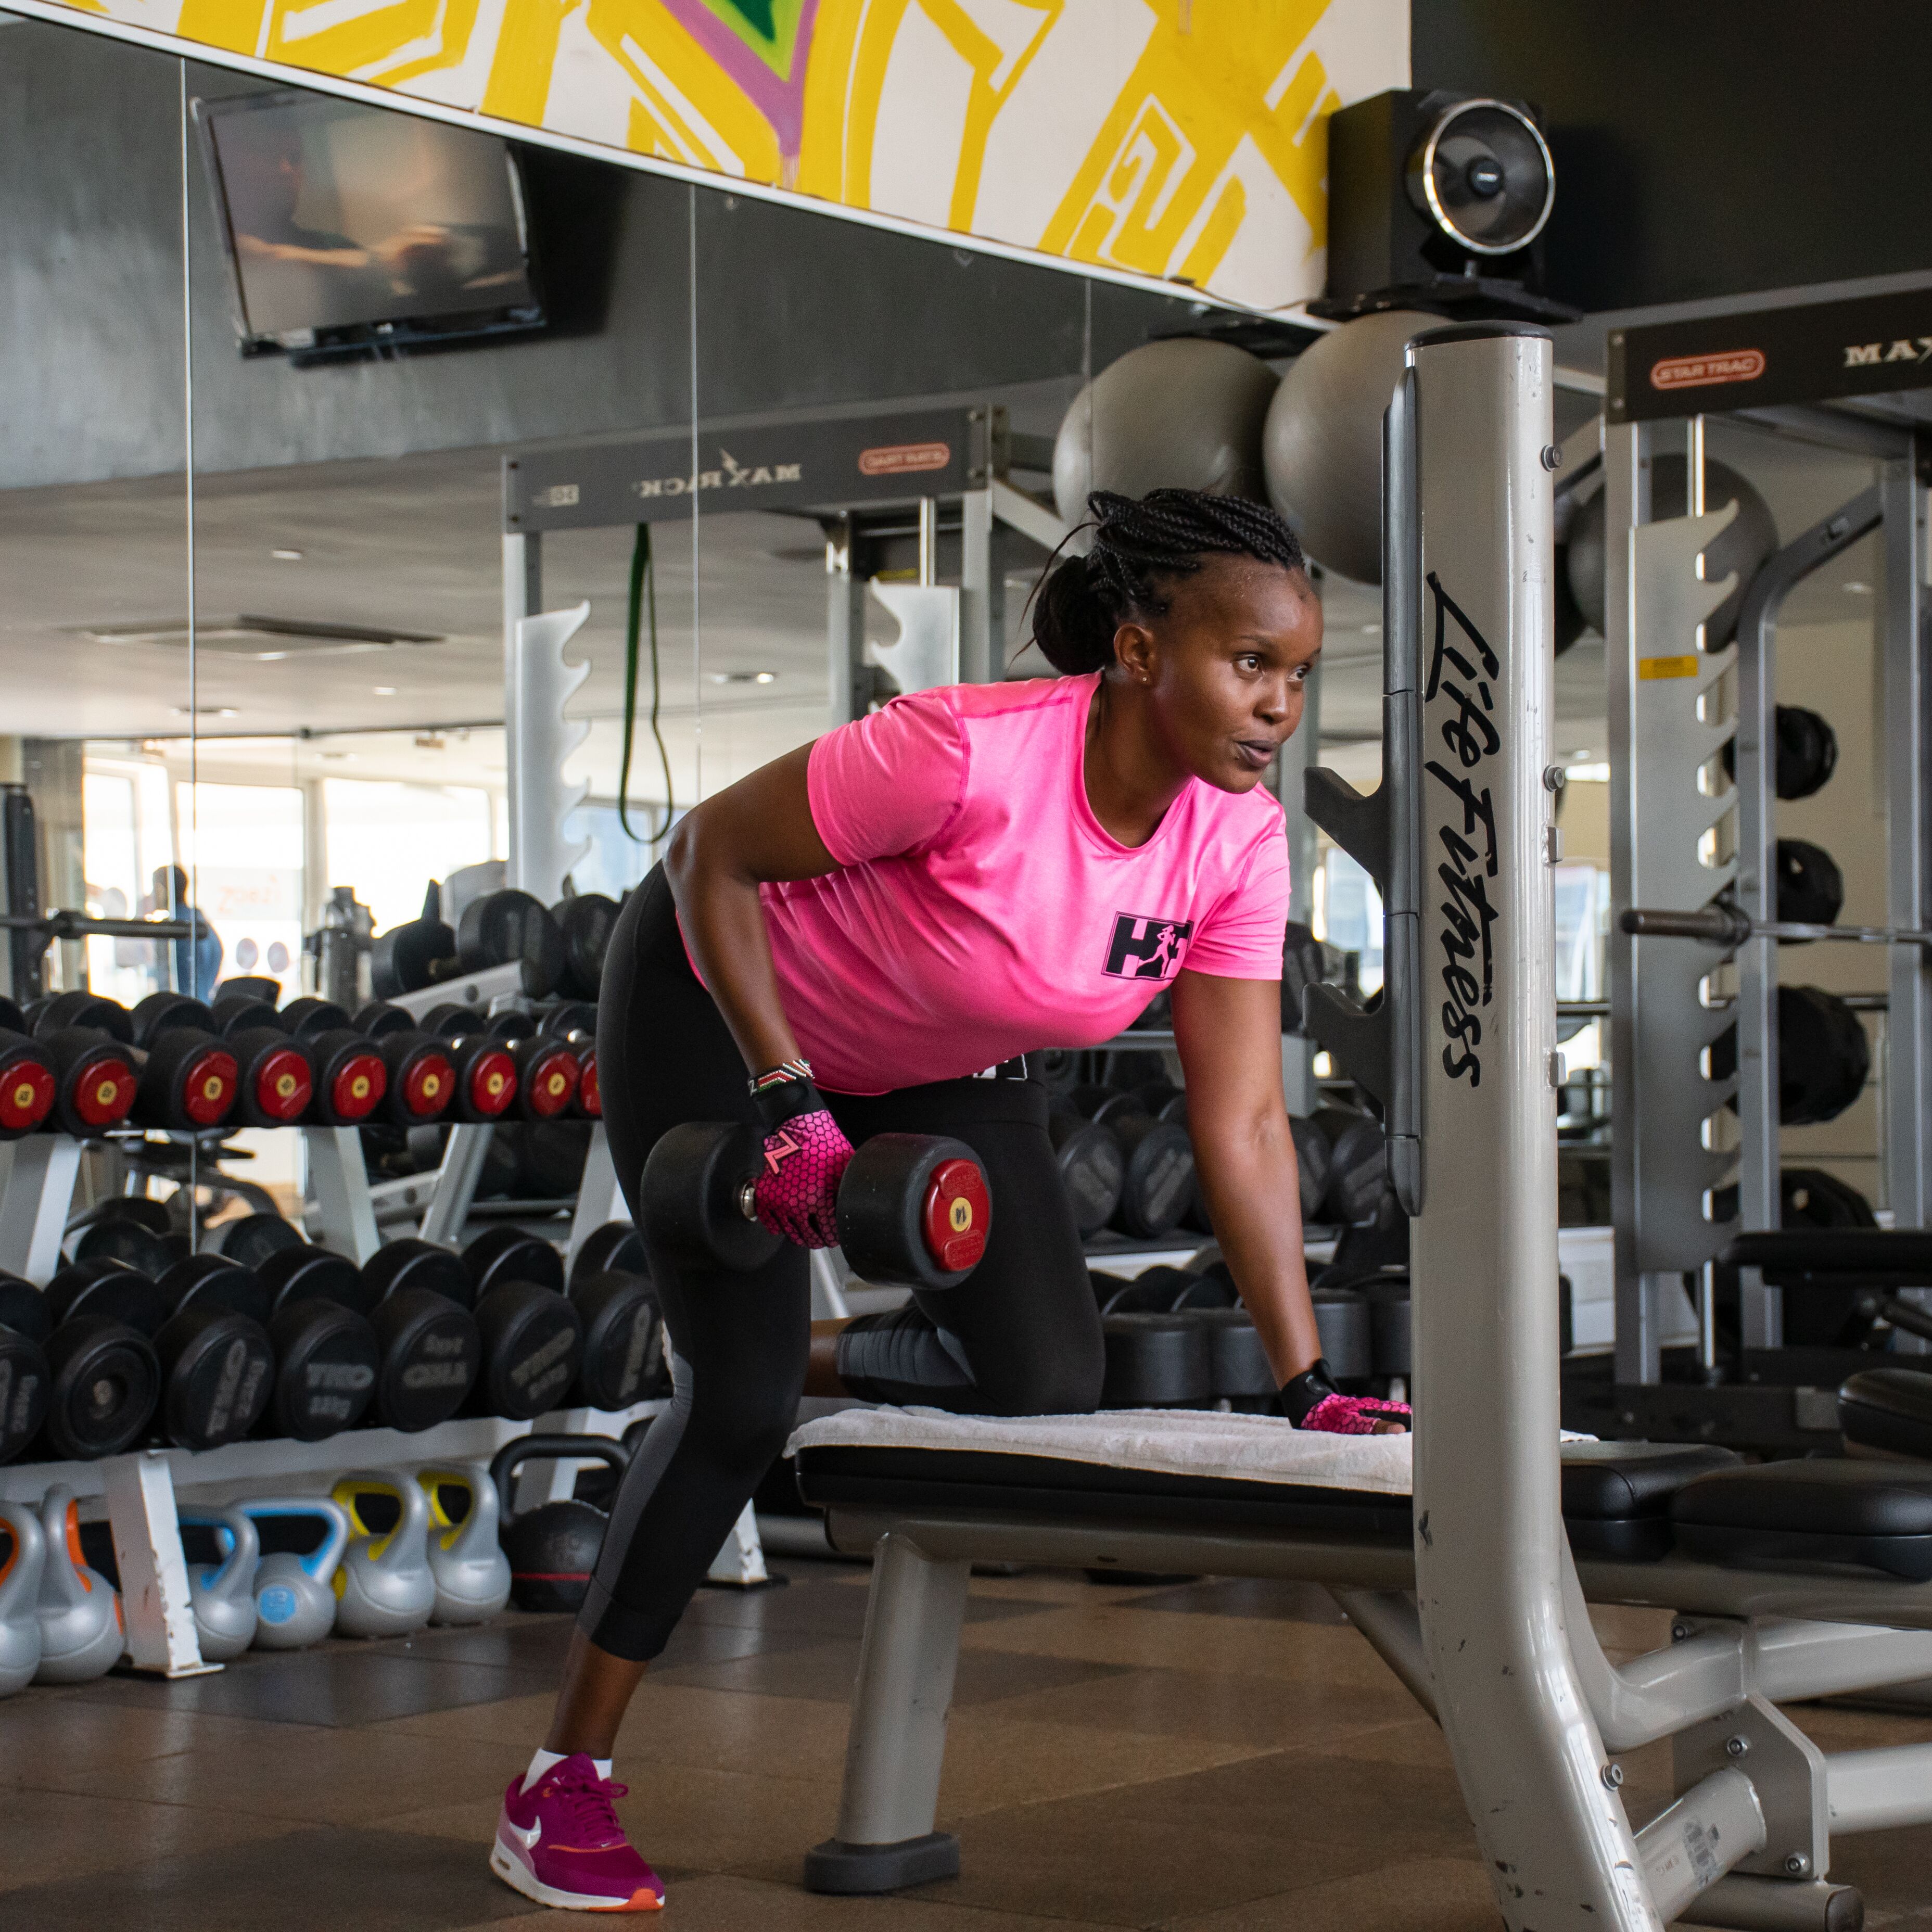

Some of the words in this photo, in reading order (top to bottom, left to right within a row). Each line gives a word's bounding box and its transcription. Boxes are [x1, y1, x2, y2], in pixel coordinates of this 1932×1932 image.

[1659, 364, 1704, 380] STAR
[1424, 571, 1501, 768] Life
[1423, 760, 1499, 1088] Fitness
